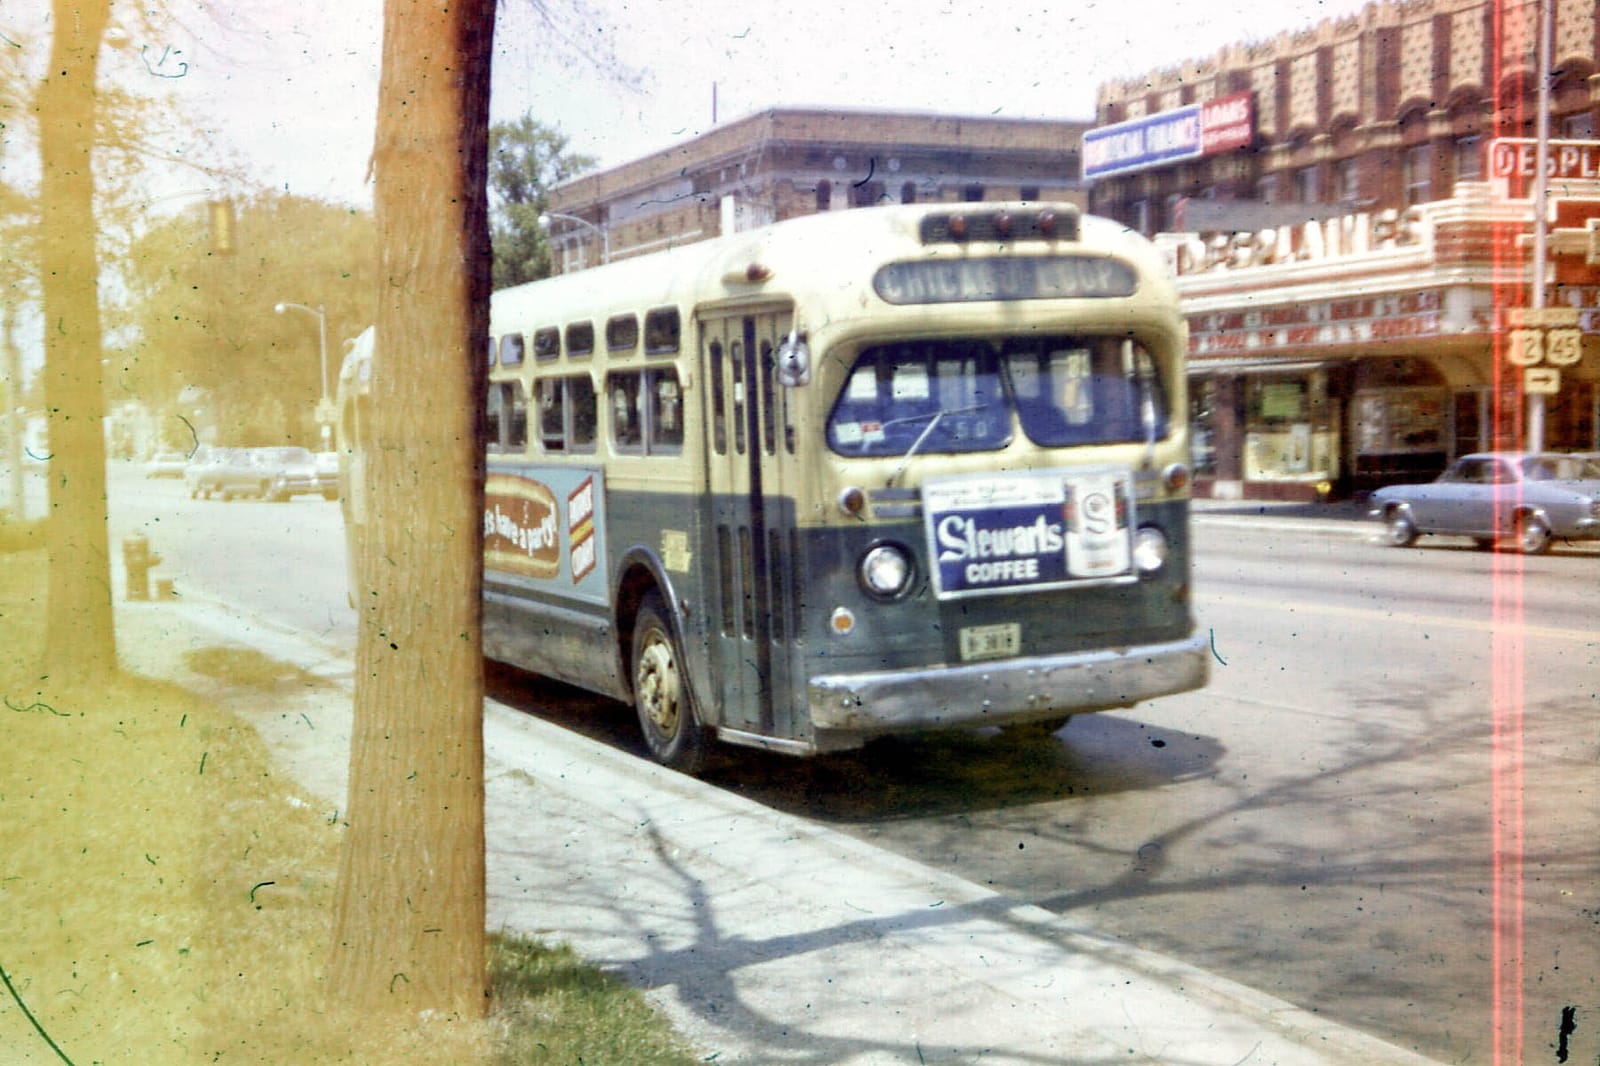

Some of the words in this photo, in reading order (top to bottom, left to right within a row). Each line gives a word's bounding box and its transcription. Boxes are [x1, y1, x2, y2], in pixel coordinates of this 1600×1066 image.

[1495, 143, 1600, 178] DESPL
[1552, 335, 1577, 360] 45
[965, 558, 1039, 584] COFFEE
